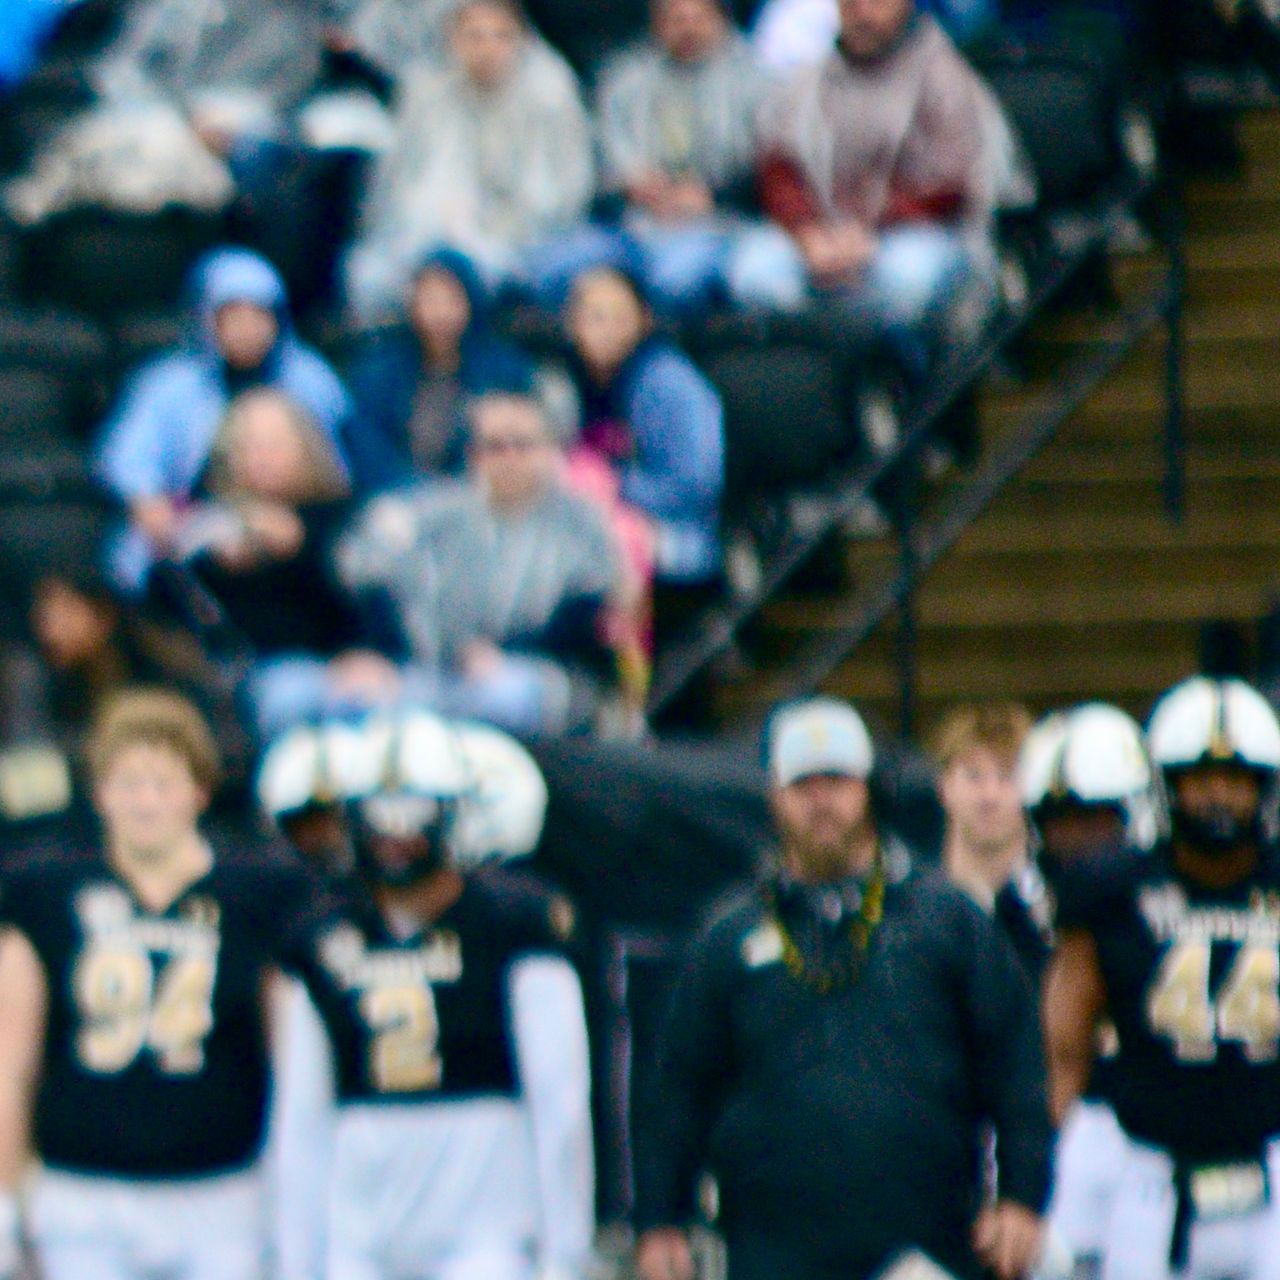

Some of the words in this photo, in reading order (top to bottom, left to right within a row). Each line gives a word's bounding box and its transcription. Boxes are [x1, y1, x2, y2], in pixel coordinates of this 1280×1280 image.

[71, 944, 215, 1074] 94
[357, 982, 443, 1094] 2
[1145, 938, 1280, 1062] 44
